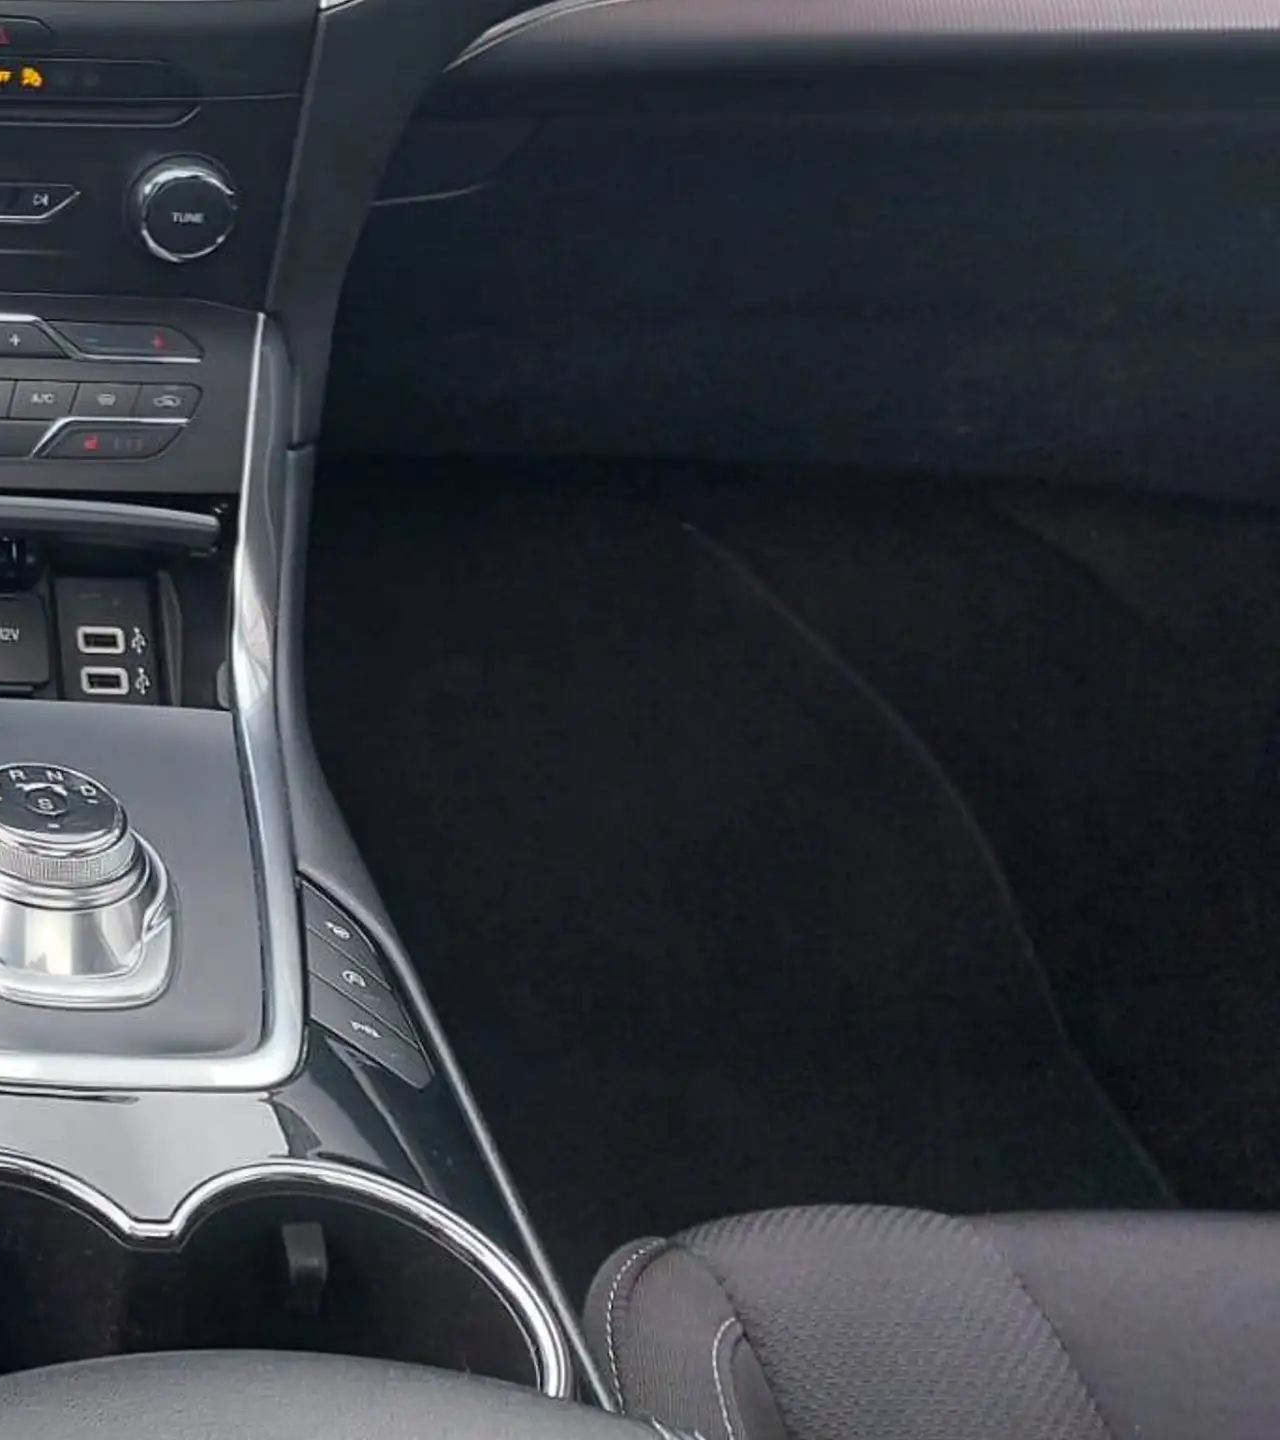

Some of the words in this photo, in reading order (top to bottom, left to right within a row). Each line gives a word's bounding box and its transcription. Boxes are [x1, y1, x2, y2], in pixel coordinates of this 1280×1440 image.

[172, 211, 205, 224] TUNE
[31, 392, 55, 404] A/C
[8, 769, 27, 782] R
[45, 770, 64, 782] N
[80, 784, 98, 797] D
